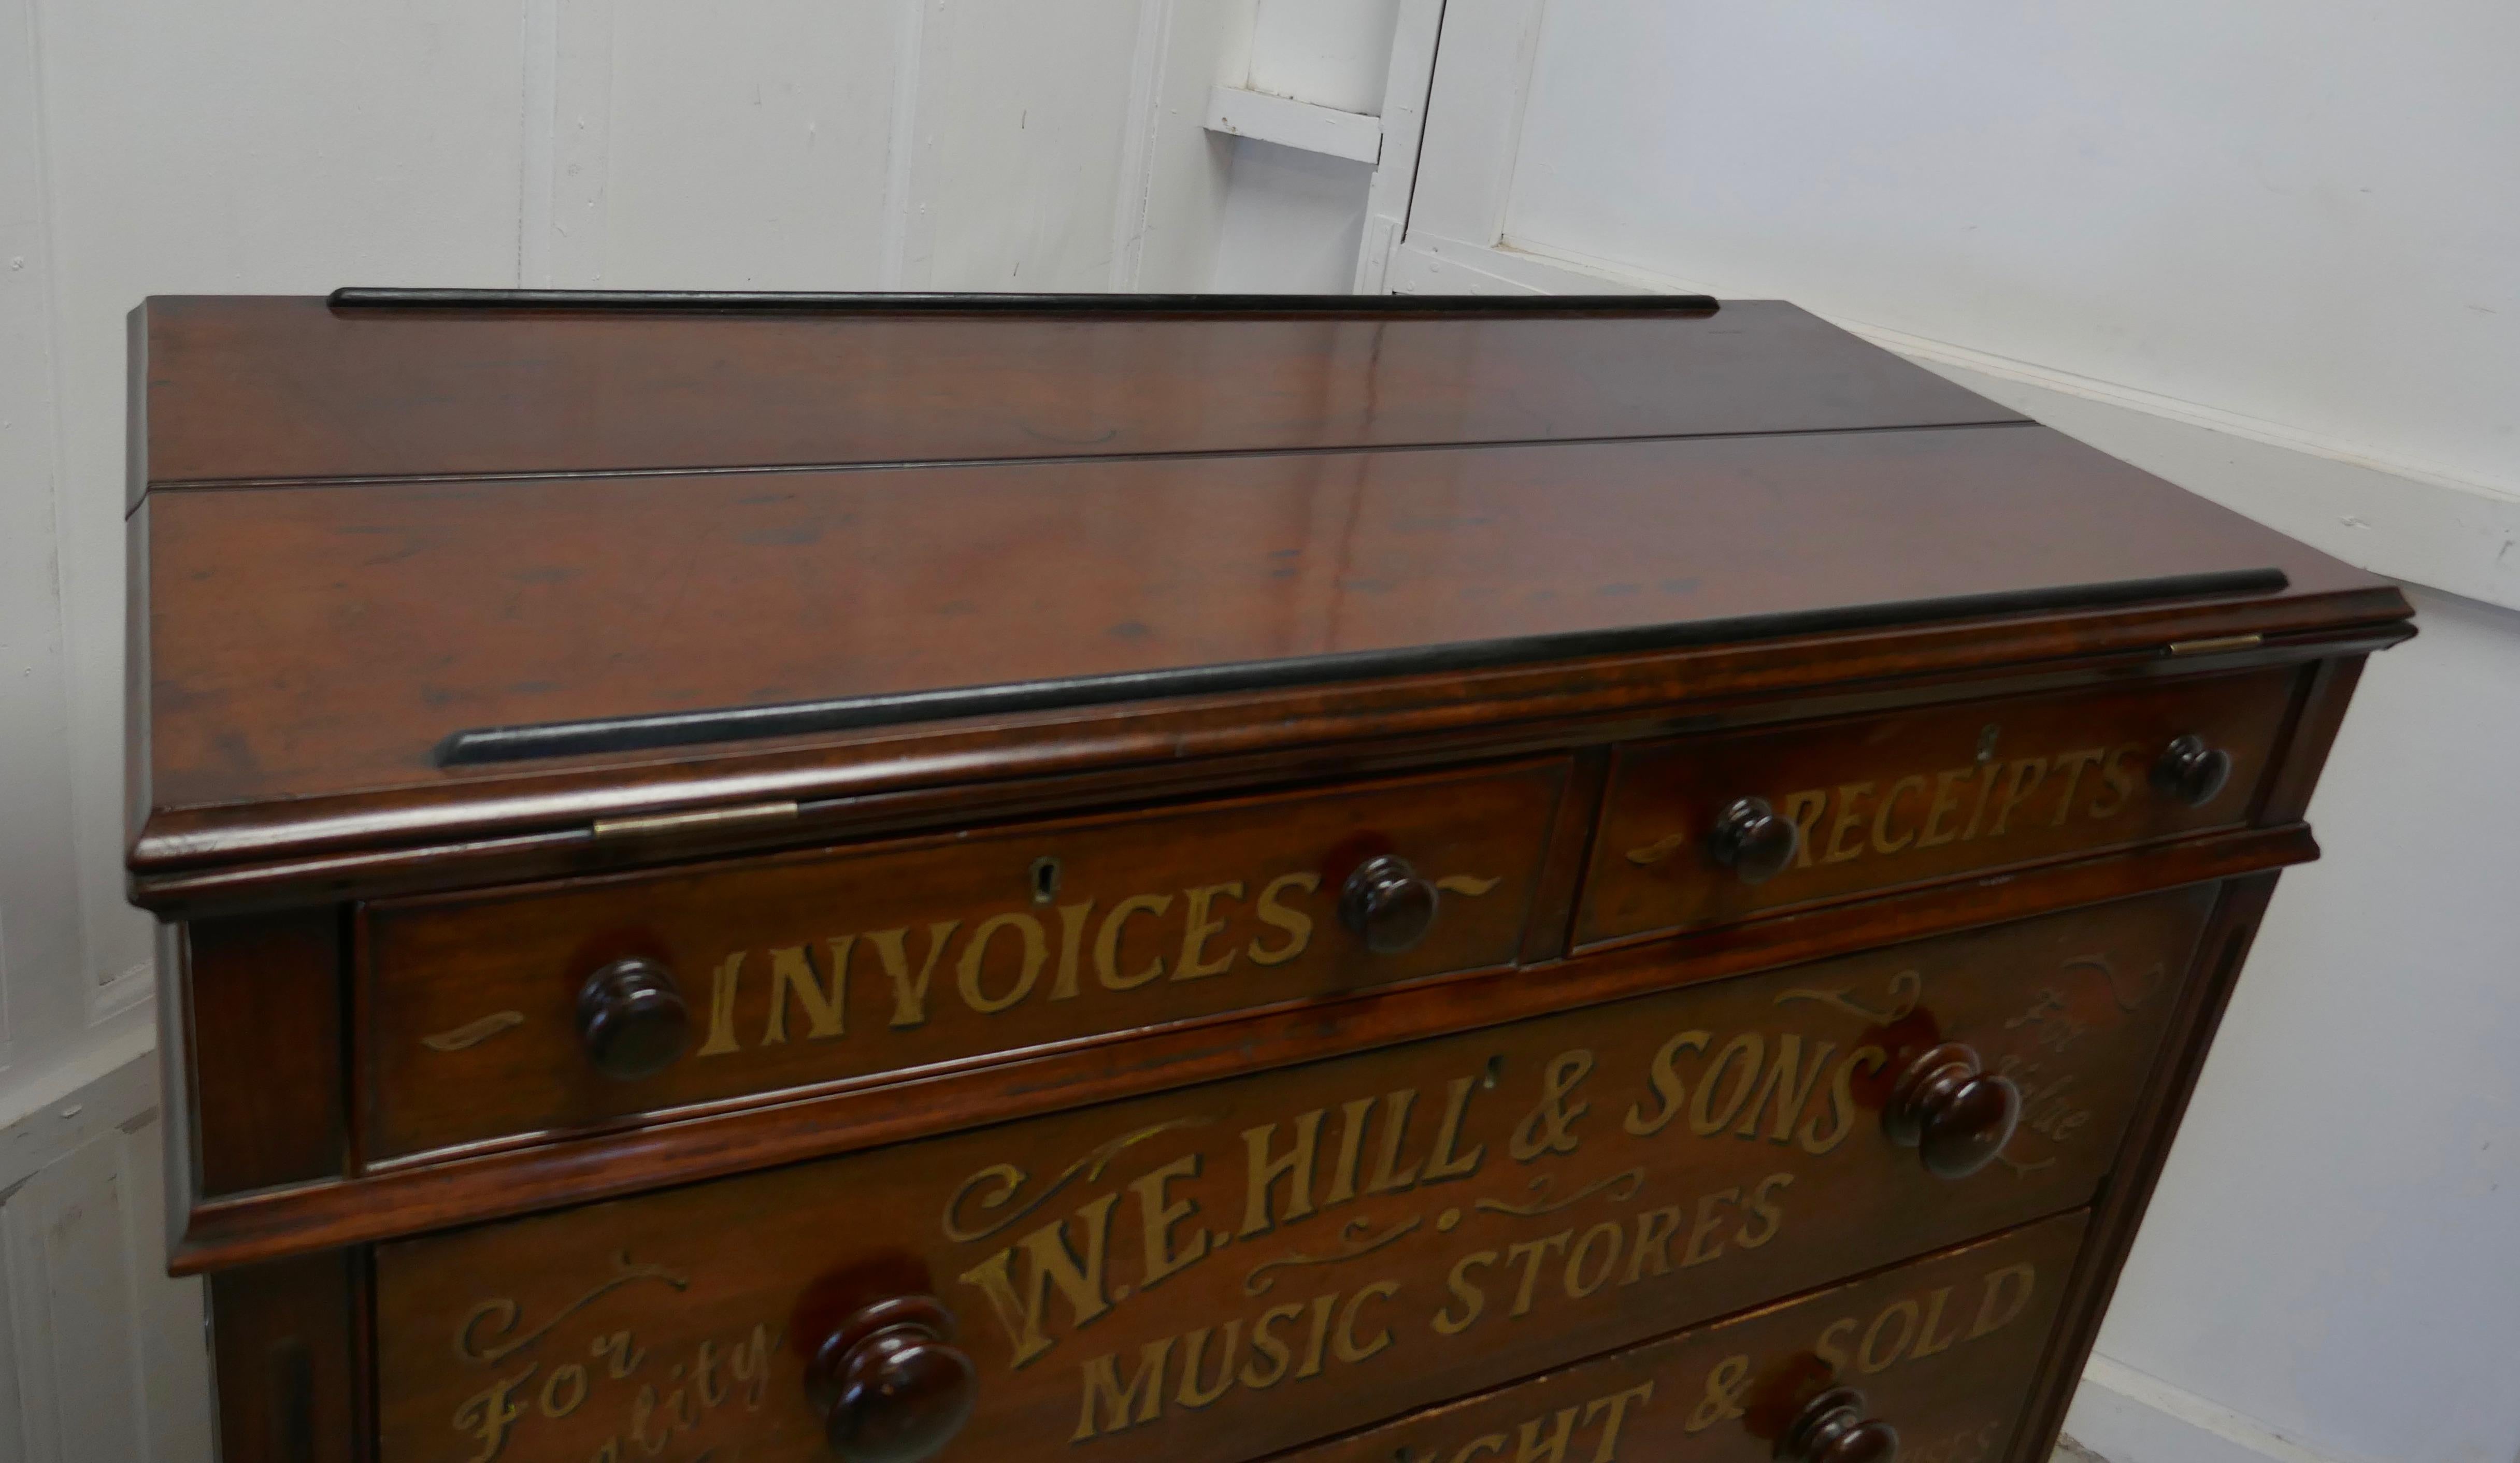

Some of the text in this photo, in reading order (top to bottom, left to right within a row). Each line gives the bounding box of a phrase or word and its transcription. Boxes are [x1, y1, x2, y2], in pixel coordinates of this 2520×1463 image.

[1785, 742, 2145, 870] RECEIPTS
[696, 871, 1322, 1058] INVOICES
[1507, 1049, 1595, 1161] &
[1625, 1029, 1886, 1155] SONS
[1070, 1173, 1796, 1444] MUSIC STORES
[1684, 1355, 1755, 1433] &
[1813, 1262, 2034, 1383] SOLD
[453, 1330, 646, 1463] For
